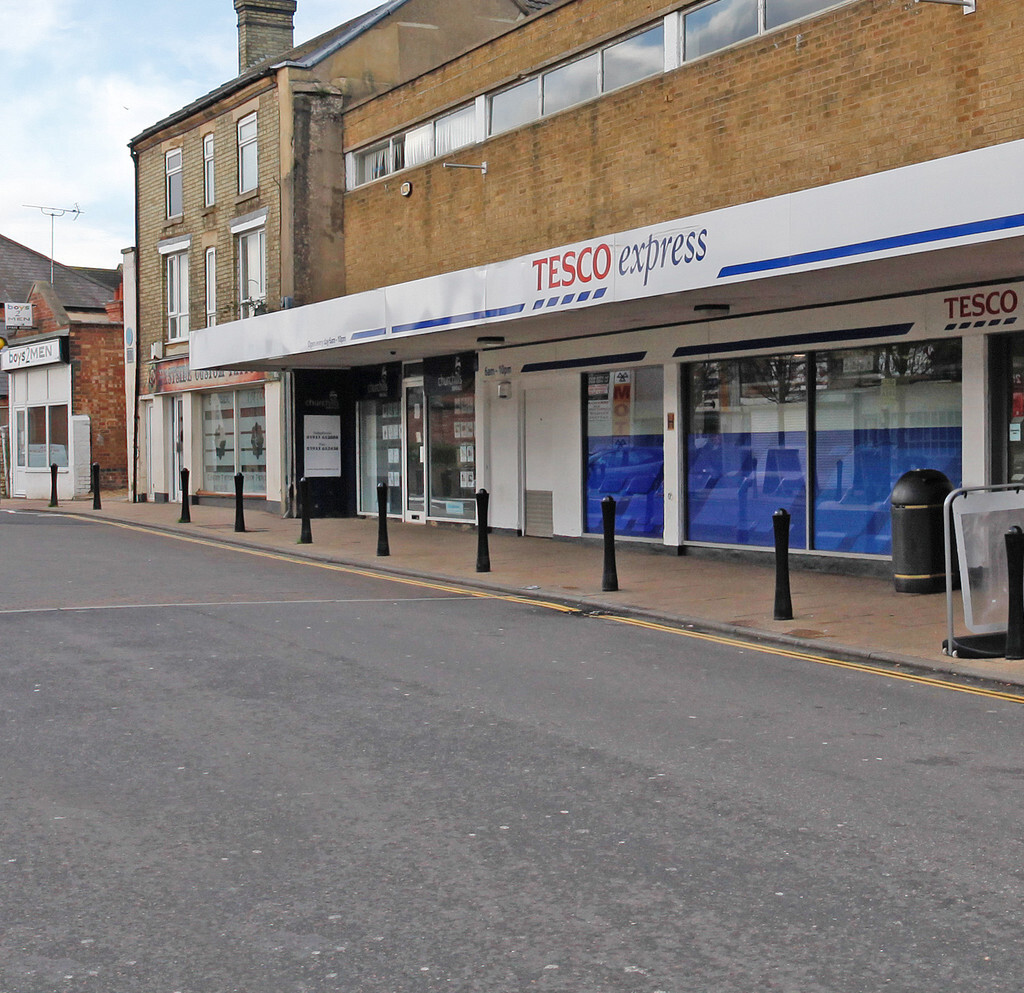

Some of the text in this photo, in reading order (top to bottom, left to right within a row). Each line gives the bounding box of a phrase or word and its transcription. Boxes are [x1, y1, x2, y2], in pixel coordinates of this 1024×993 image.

[532, 228, 708, 291] TESCO express
[943, 289, 1019, 319] TESCO
